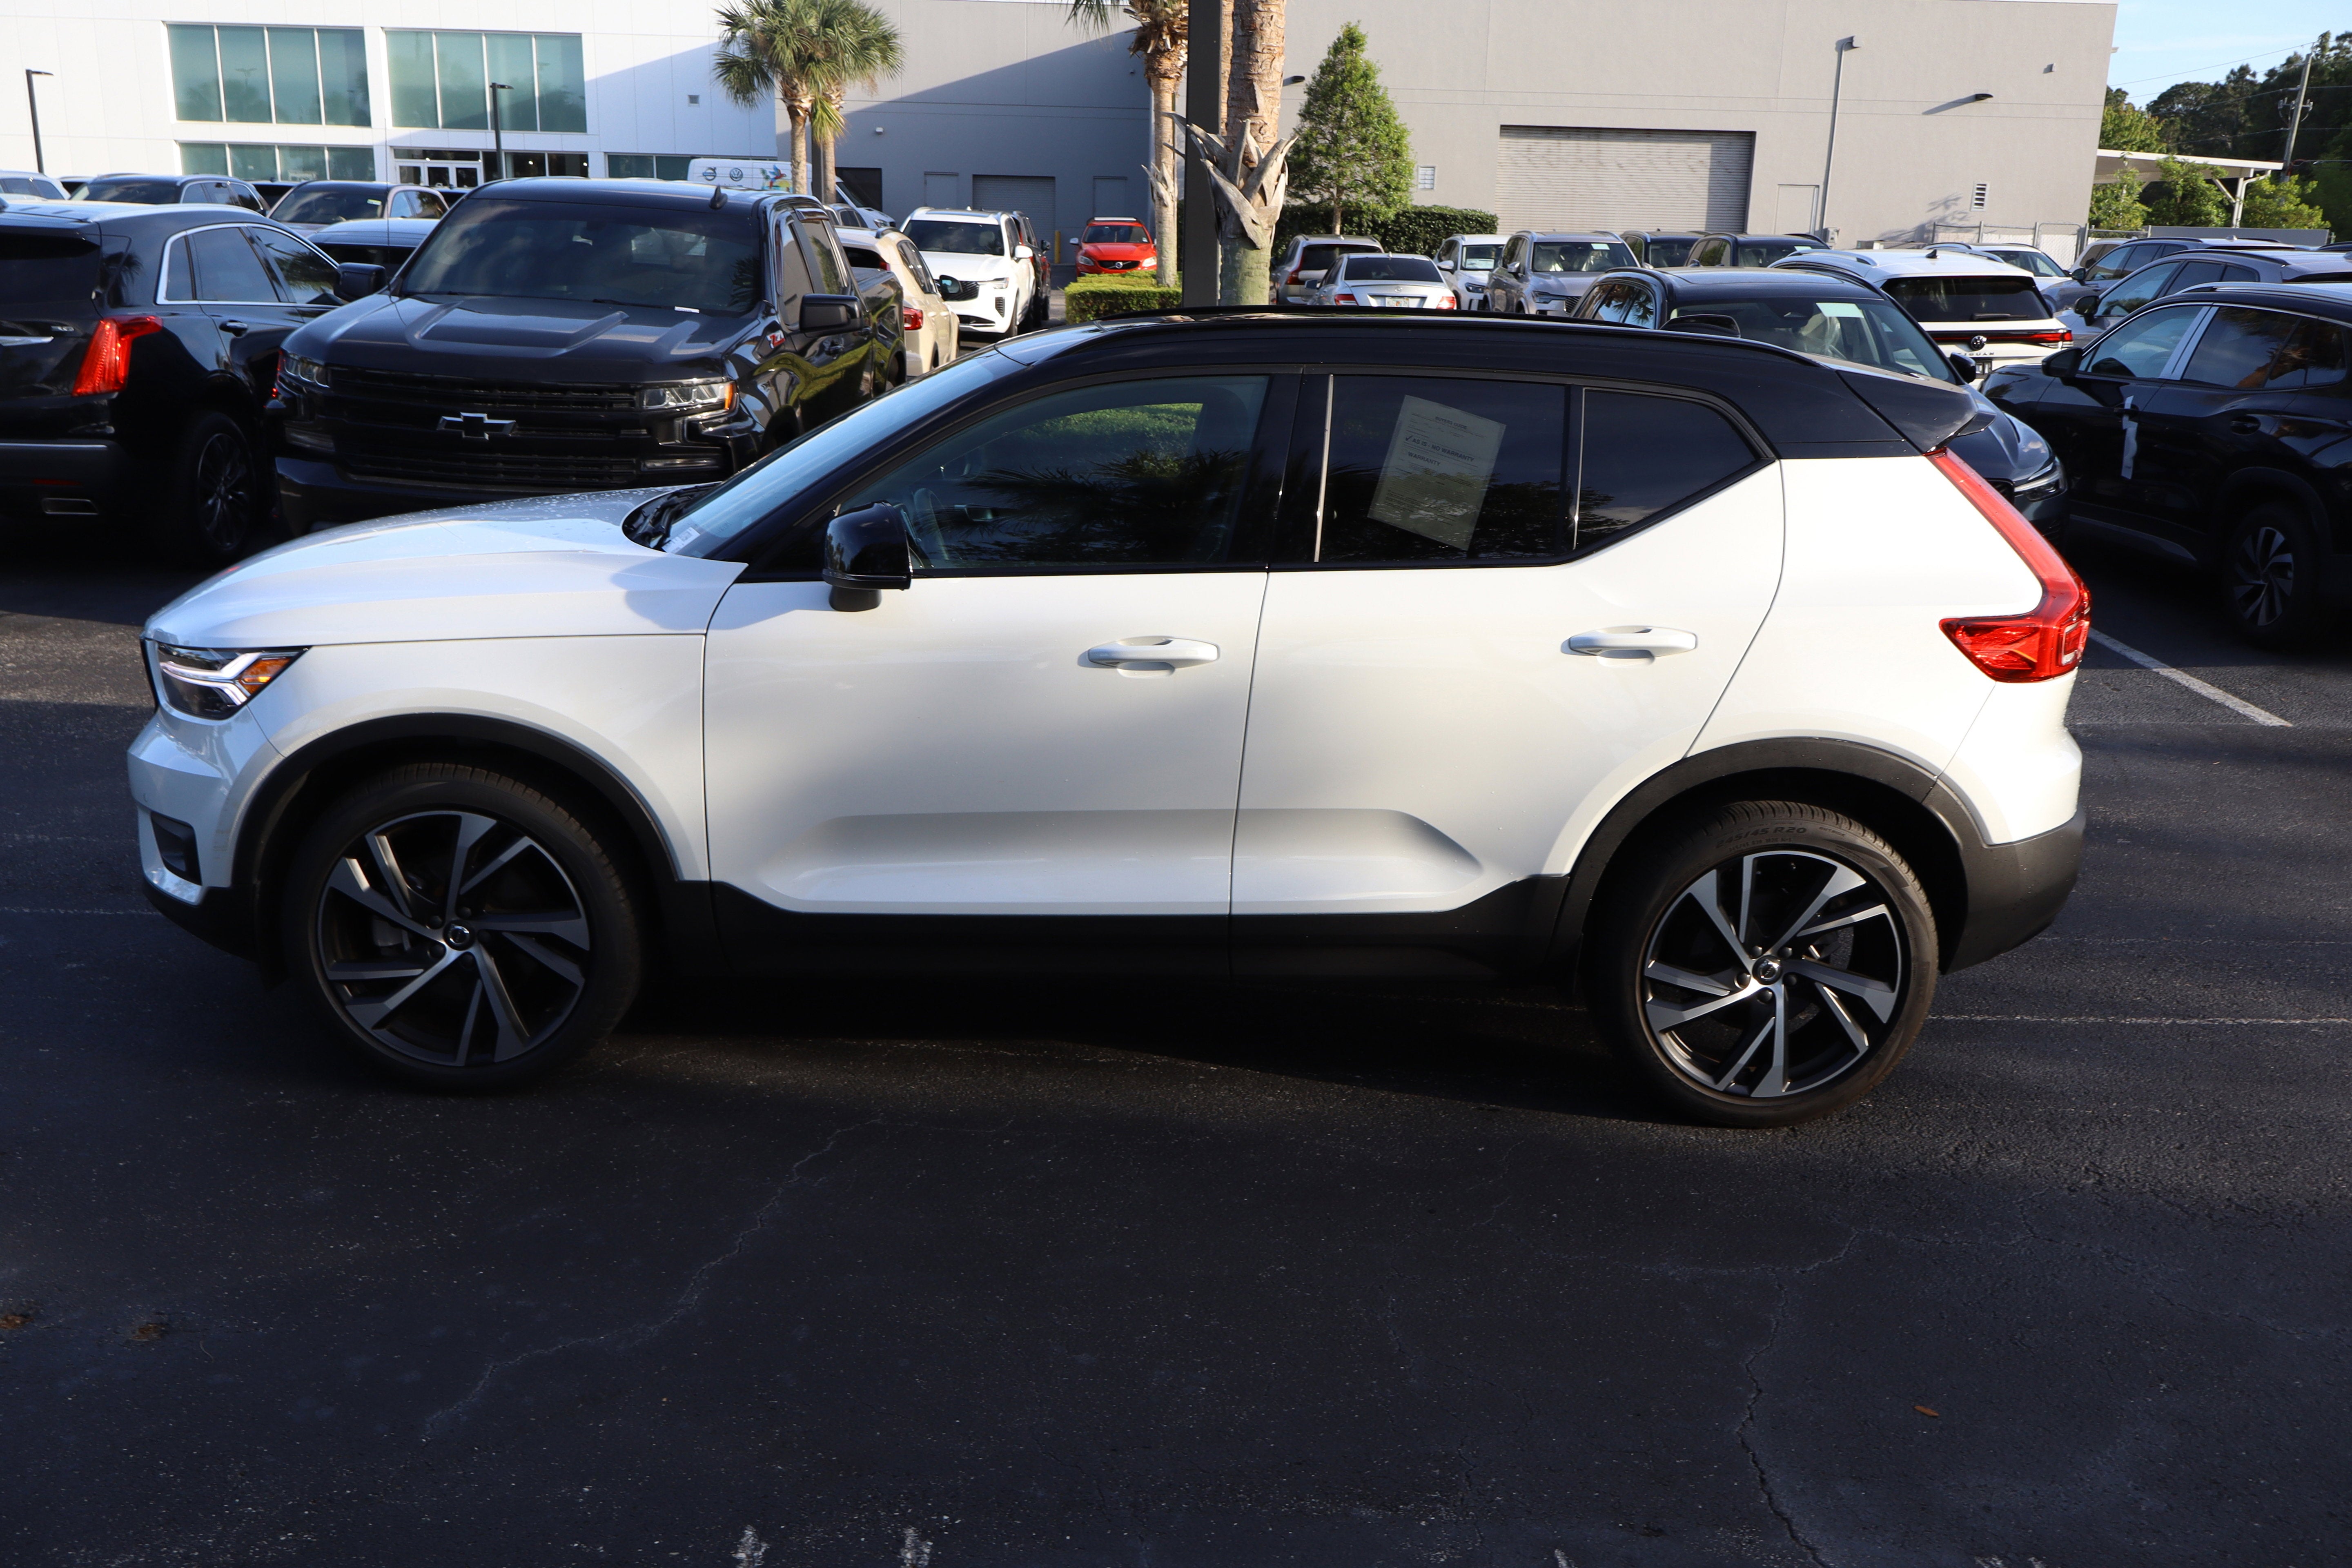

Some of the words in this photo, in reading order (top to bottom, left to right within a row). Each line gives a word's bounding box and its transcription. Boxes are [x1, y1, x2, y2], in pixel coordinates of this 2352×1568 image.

[1435, 416, 1453, 425] BUYERS
[1408, 451, 1441, 466] WARRANTY
[1441, 448, 1474, 462] WARRANTY
[1715, 827, 1769, 849] 245/45
